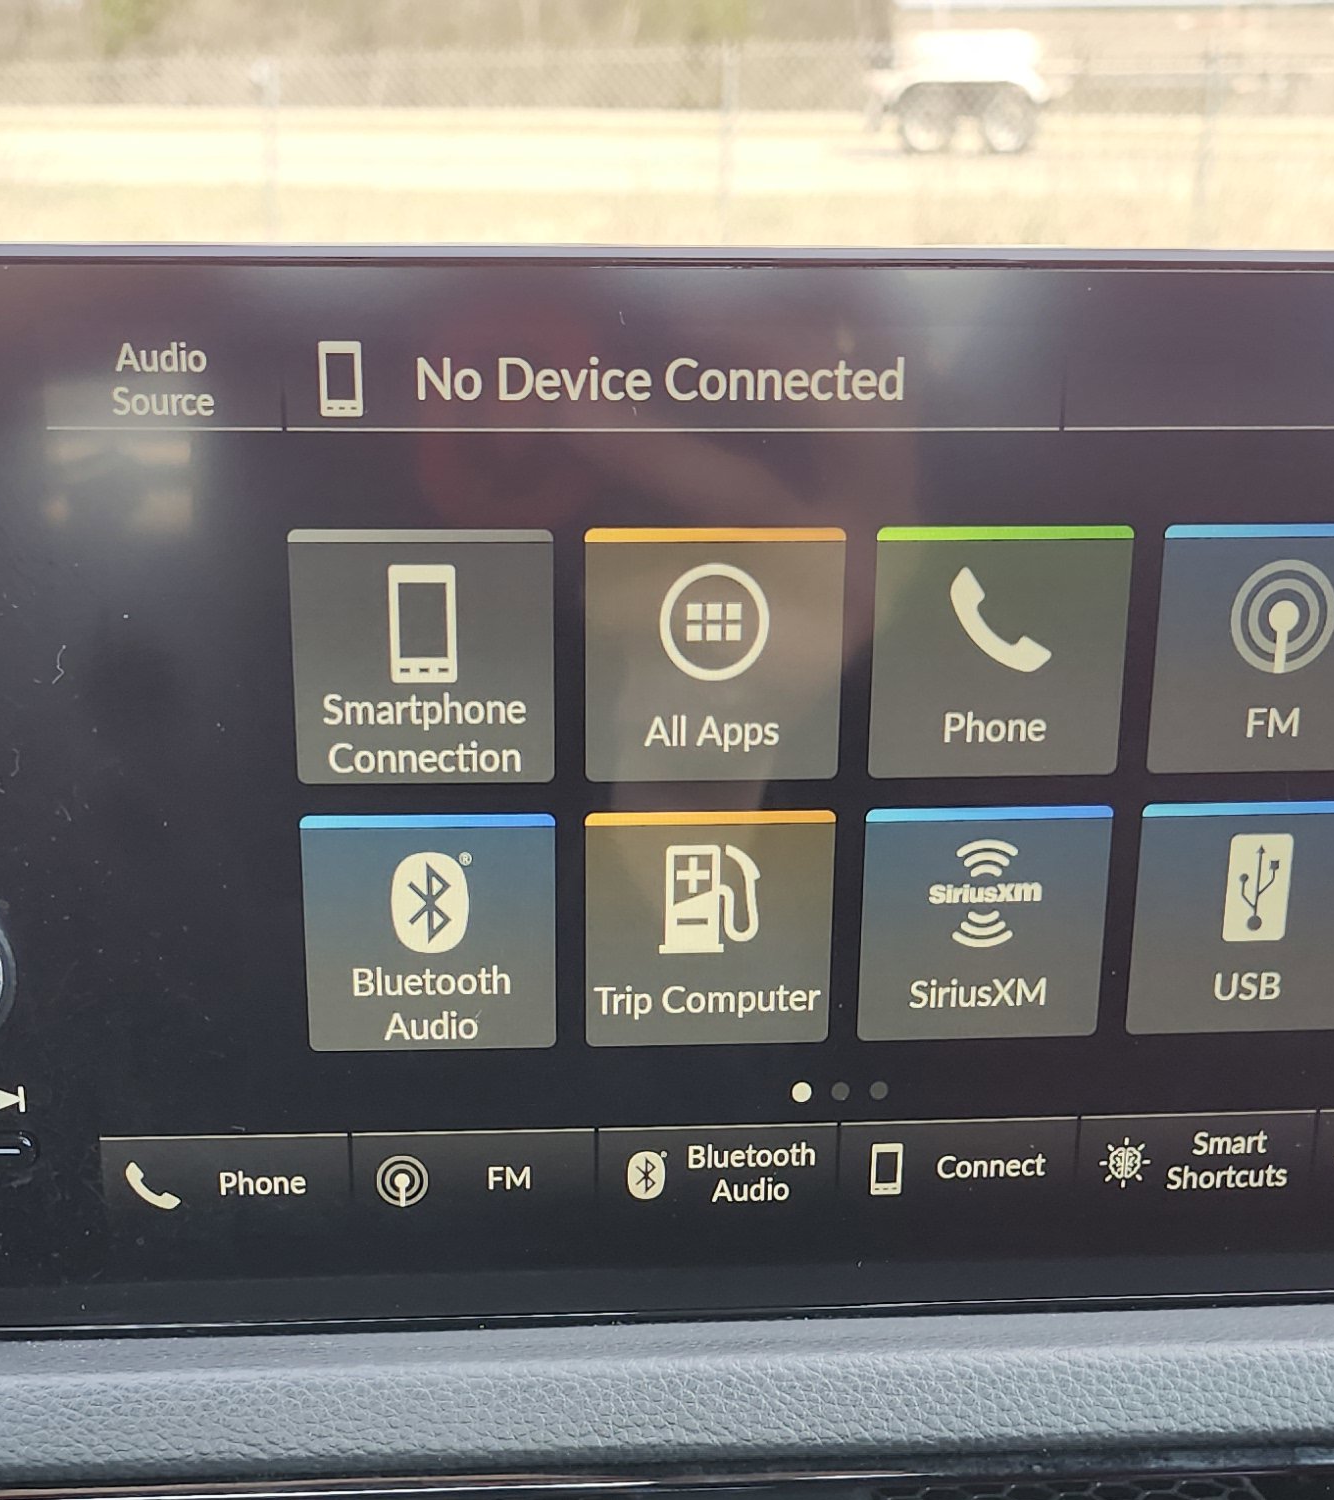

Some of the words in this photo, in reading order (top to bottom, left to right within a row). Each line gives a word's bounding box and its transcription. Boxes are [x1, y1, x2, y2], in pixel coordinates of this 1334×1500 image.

[115, 341, 207, 373] Audio
[416, 356, 483, 401] No
[498, 356, 652, 401] Device
[664, 356, 905, 401] Connected
[112, 386, 215, 417] Source
[323, 691, 527, 731] Smartphone
[1246, 707, 1300, 738] FM
[644, 714, 687, 747] All
[695, 715, 780, 753] Apps
[943, 711, 1047, 743] Phone
[328, 740, 522, 774] Connection
[352, 964, 511, 997] Bluetooth
[909, 977, 1047, 1009] SiriusXM
[1214, 971, 1281, 1001] USB
[593, 985, 652, 1021] Trip
[661, 984, 822, 1019] Computer
[384, 1010, 479, 1041] Audio
[688, 1141, 816, 1169] Bluetooth
[1192, 1130, 1268, 1156] Smart
[488, 1166, 531, 1190] FM
[937, 1153, 1046, 1179] Connect
[1166, 1164, 1288, 1190] Shortcuts
[219, 1170, 306, 1196] Phone
[711, 1176, 790, 1203] Audio
